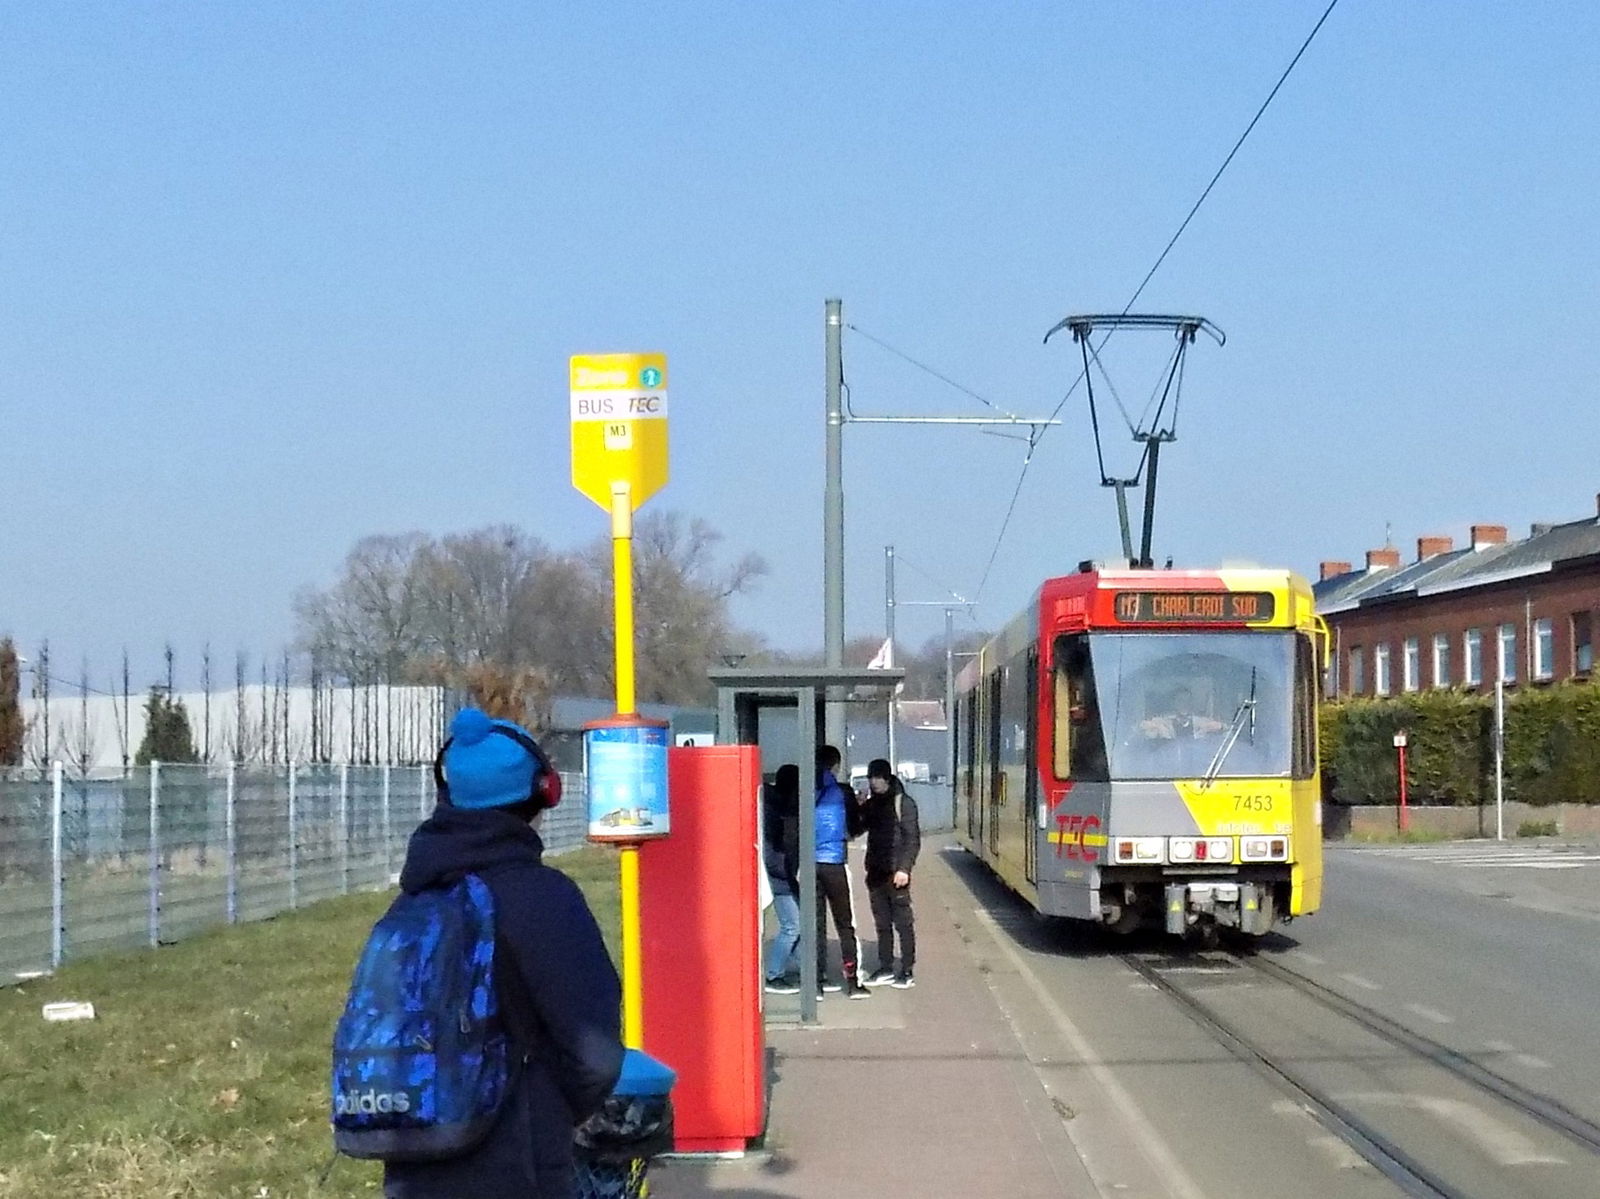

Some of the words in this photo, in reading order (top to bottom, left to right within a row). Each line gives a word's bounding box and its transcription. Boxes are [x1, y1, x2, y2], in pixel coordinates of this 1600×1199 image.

[578, 399, 614, 414] BUS
[628, 396, 660, 413] TEC
[610, 425, 626, 436] M3
[1152, 596, 1224, 616] CHARLEROI
[1232, 596, 1257, 616] SUD
[1233, 795, 1272, 811] 7453
[1056, 814, 1101, 863] TEC
[335, 1088, 410, 1115] adidas
